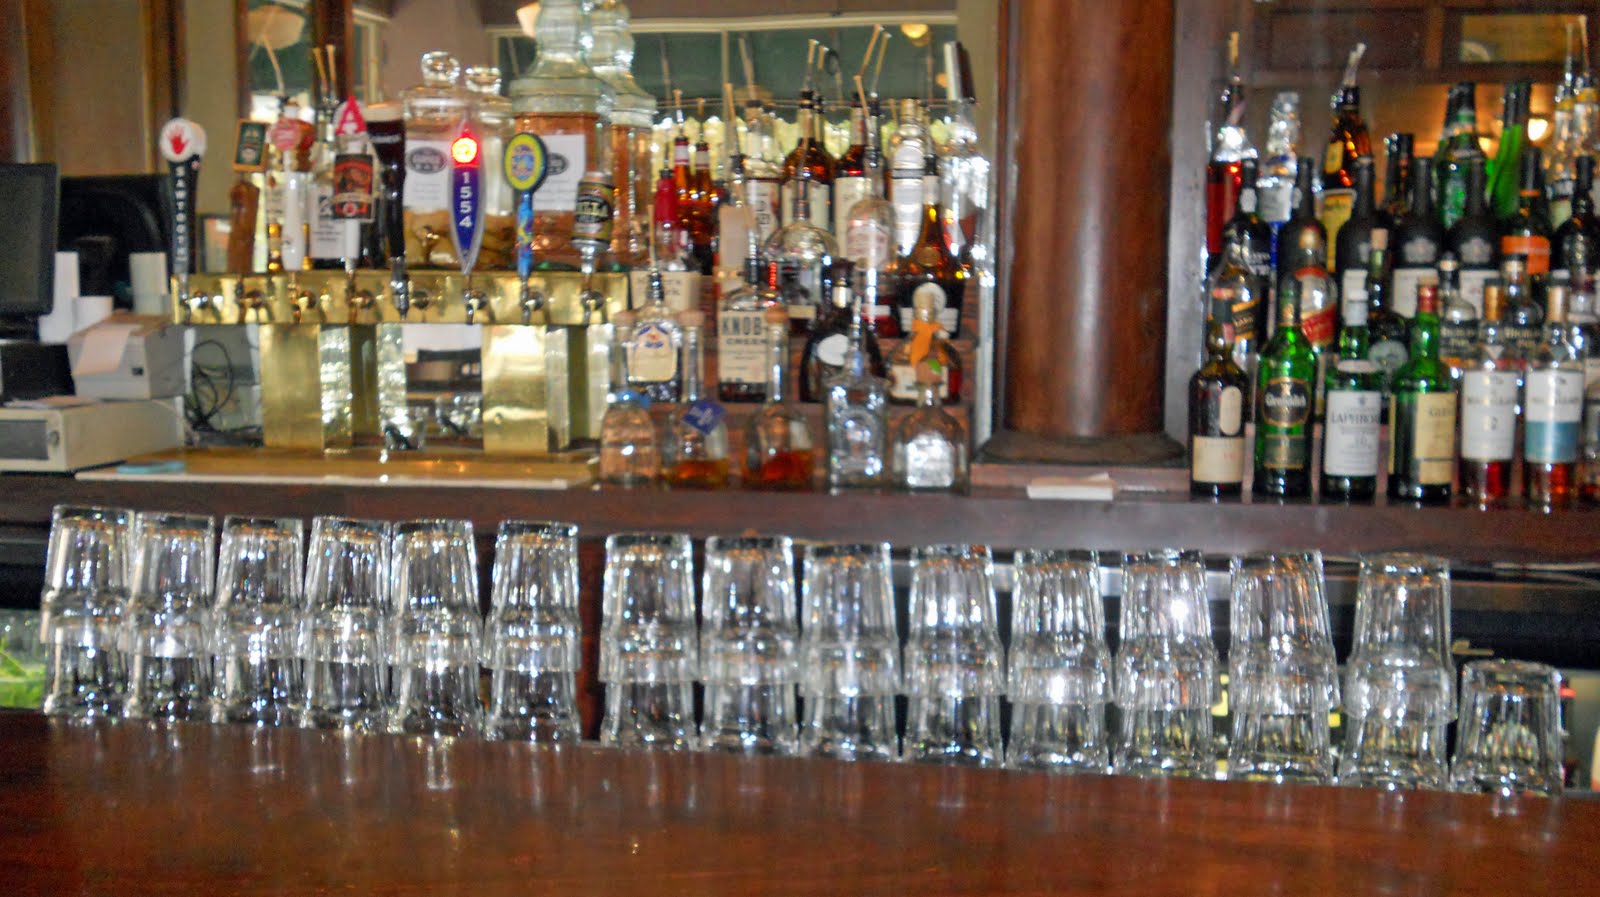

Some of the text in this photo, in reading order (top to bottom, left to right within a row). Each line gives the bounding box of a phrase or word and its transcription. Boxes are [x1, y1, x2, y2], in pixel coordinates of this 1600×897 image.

[175, 165, 187, 256] SAWTOOTH
[458, 171, 473, 228] 1554
[721, 316, 762, 336] KNOB
